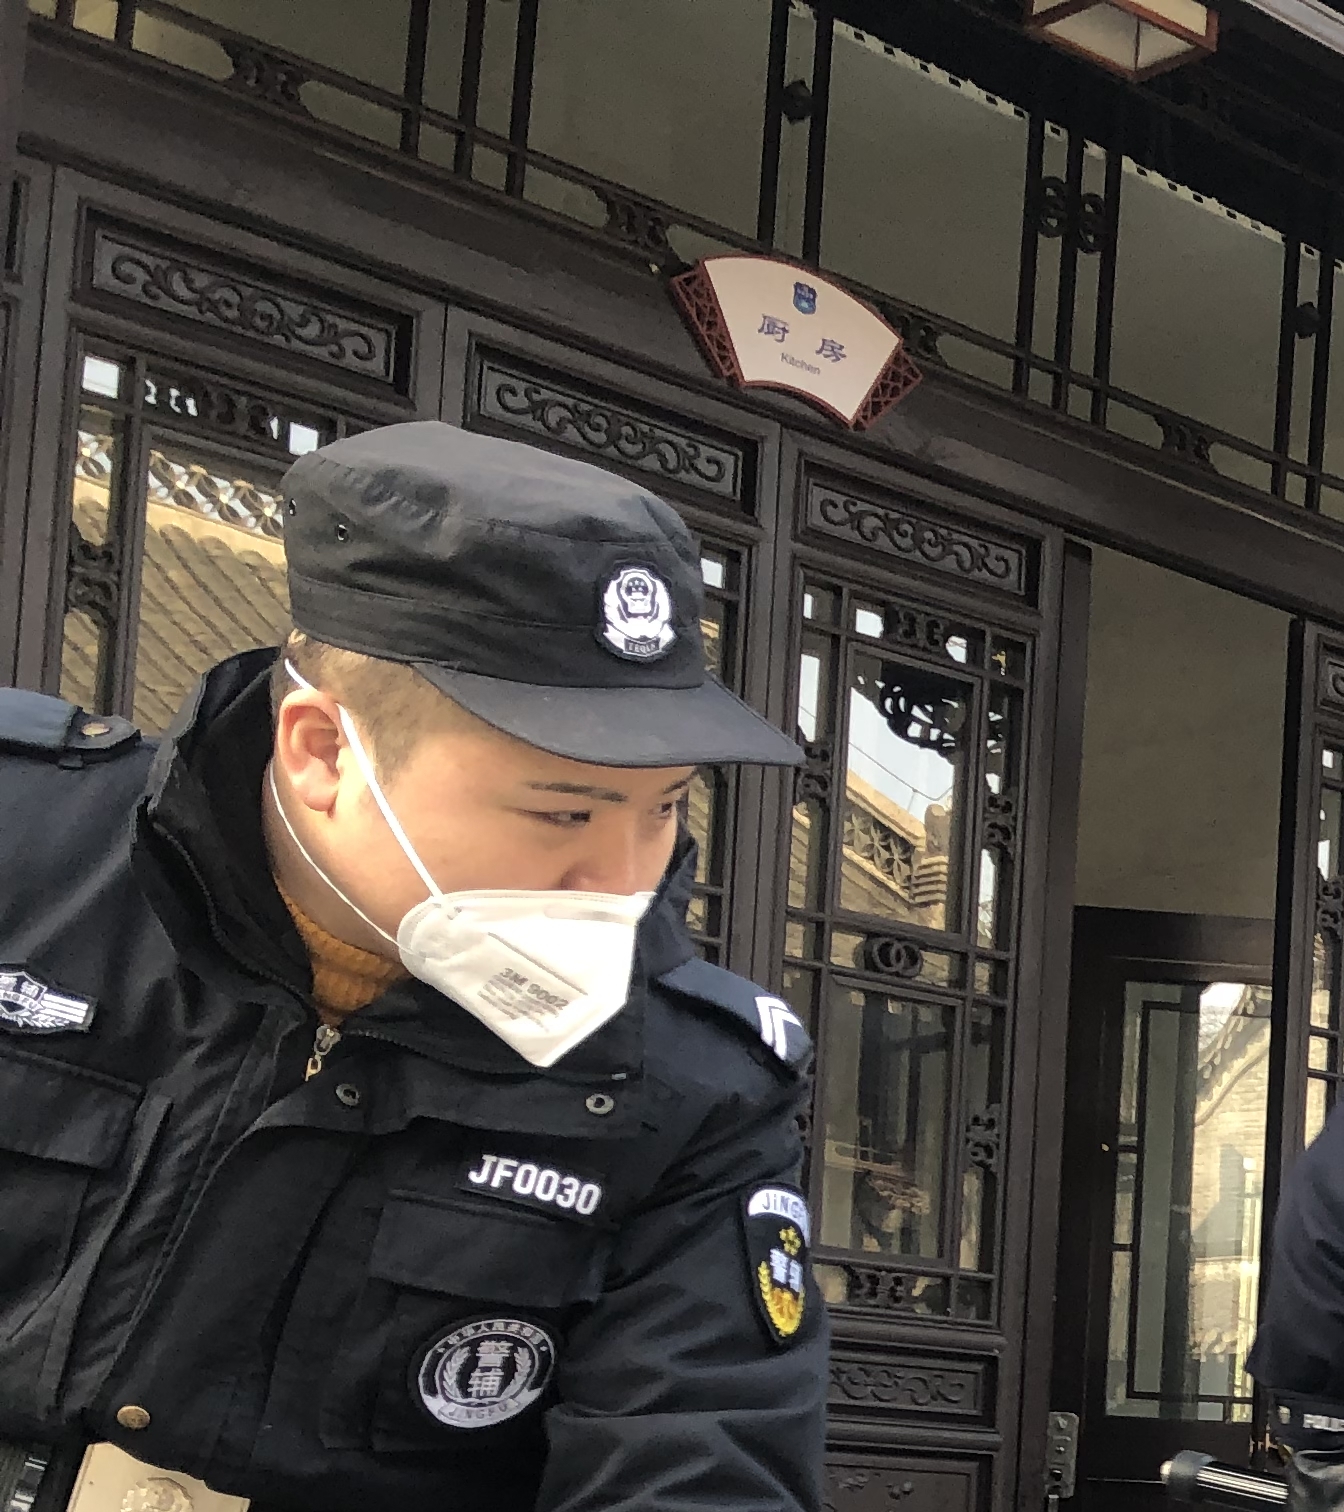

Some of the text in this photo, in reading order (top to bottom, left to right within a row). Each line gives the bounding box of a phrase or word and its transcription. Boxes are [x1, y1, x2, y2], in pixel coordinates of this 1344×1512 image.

[758, 314, 847, 363] 厨房
[780, 352, 821, 375] Kitchen
[500, 968, 528, 985] 3M
[468, 1154, 602, 1215] JF0030
